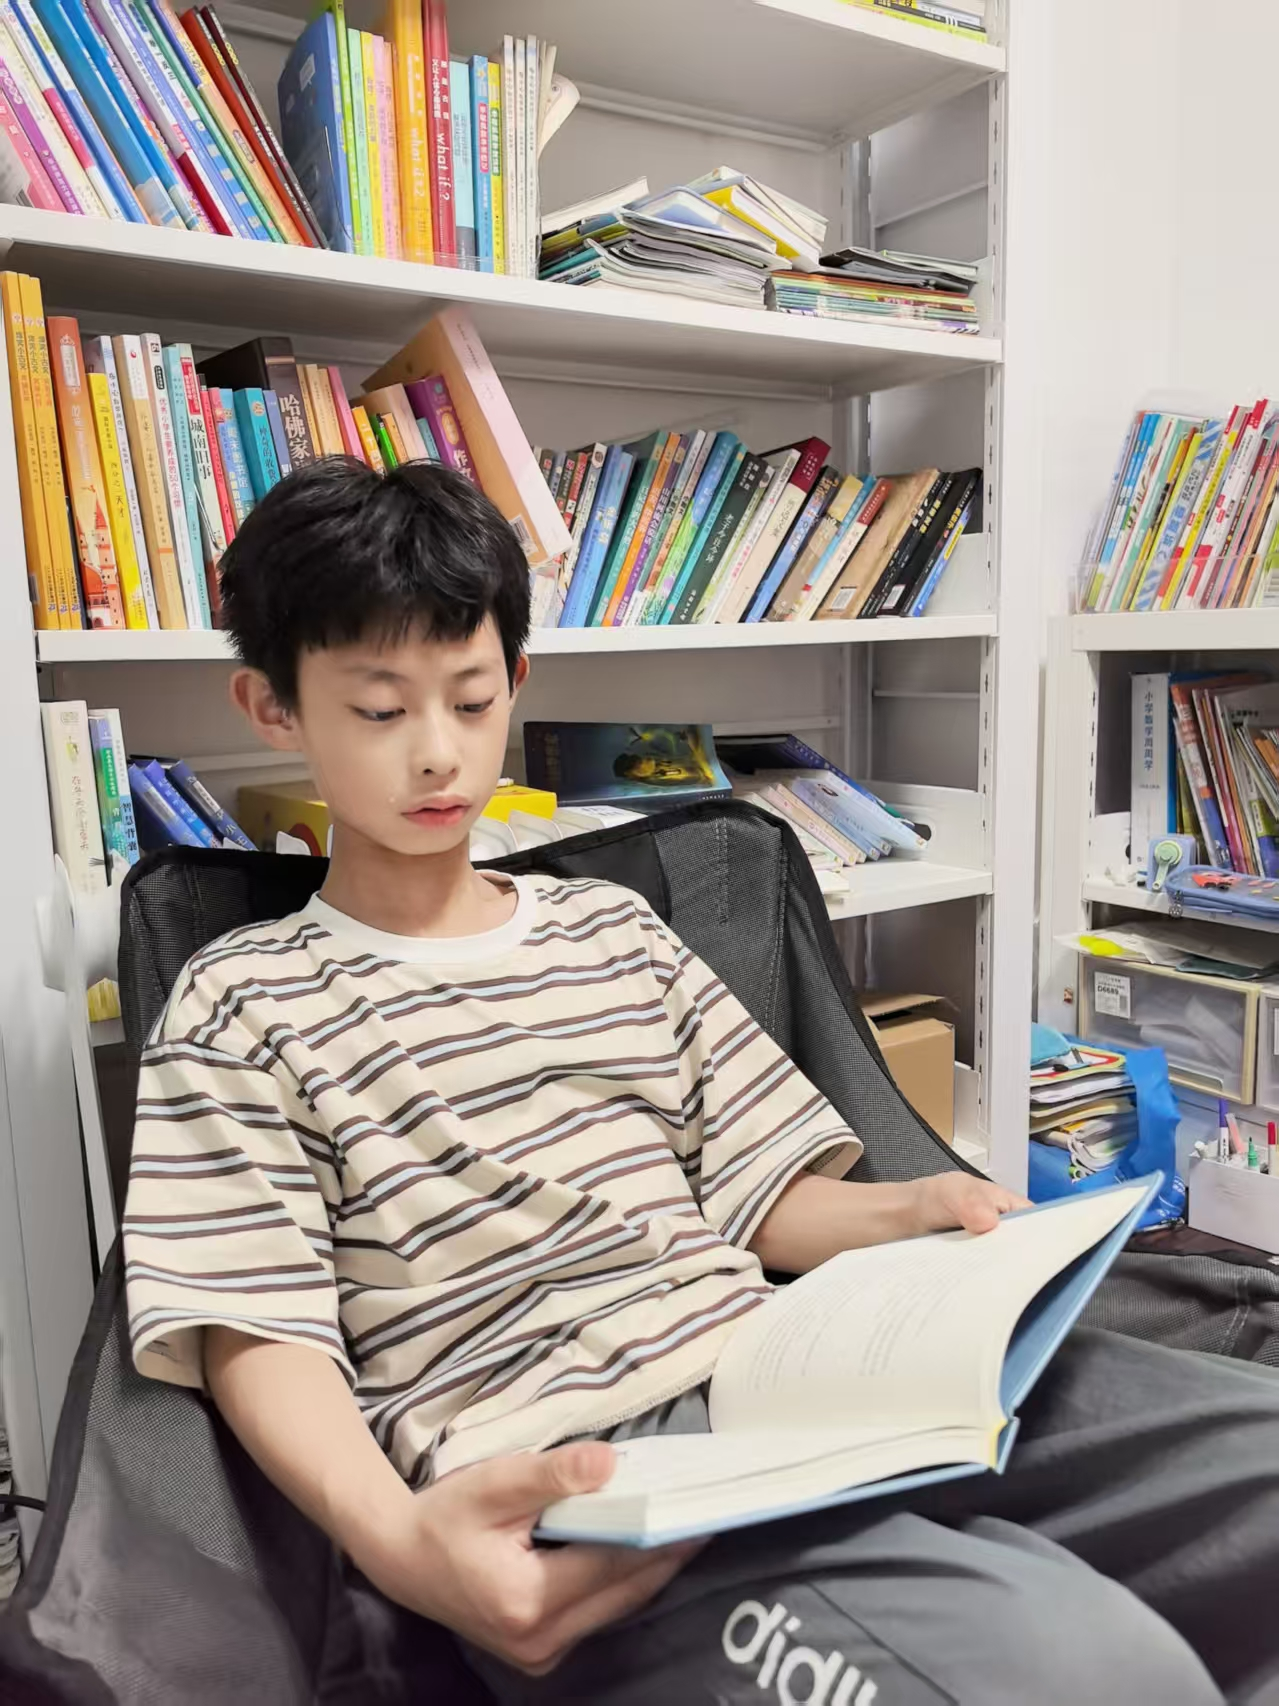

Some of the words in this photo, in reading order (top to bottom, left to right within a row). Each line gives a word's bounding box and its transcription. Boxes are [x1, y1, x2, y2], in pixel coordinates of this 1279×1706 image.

[436, 132, 450, 170] what
[190, 417, 212, 480] 城南旧事
[120, 802, 139, 851] 智慧背囊
